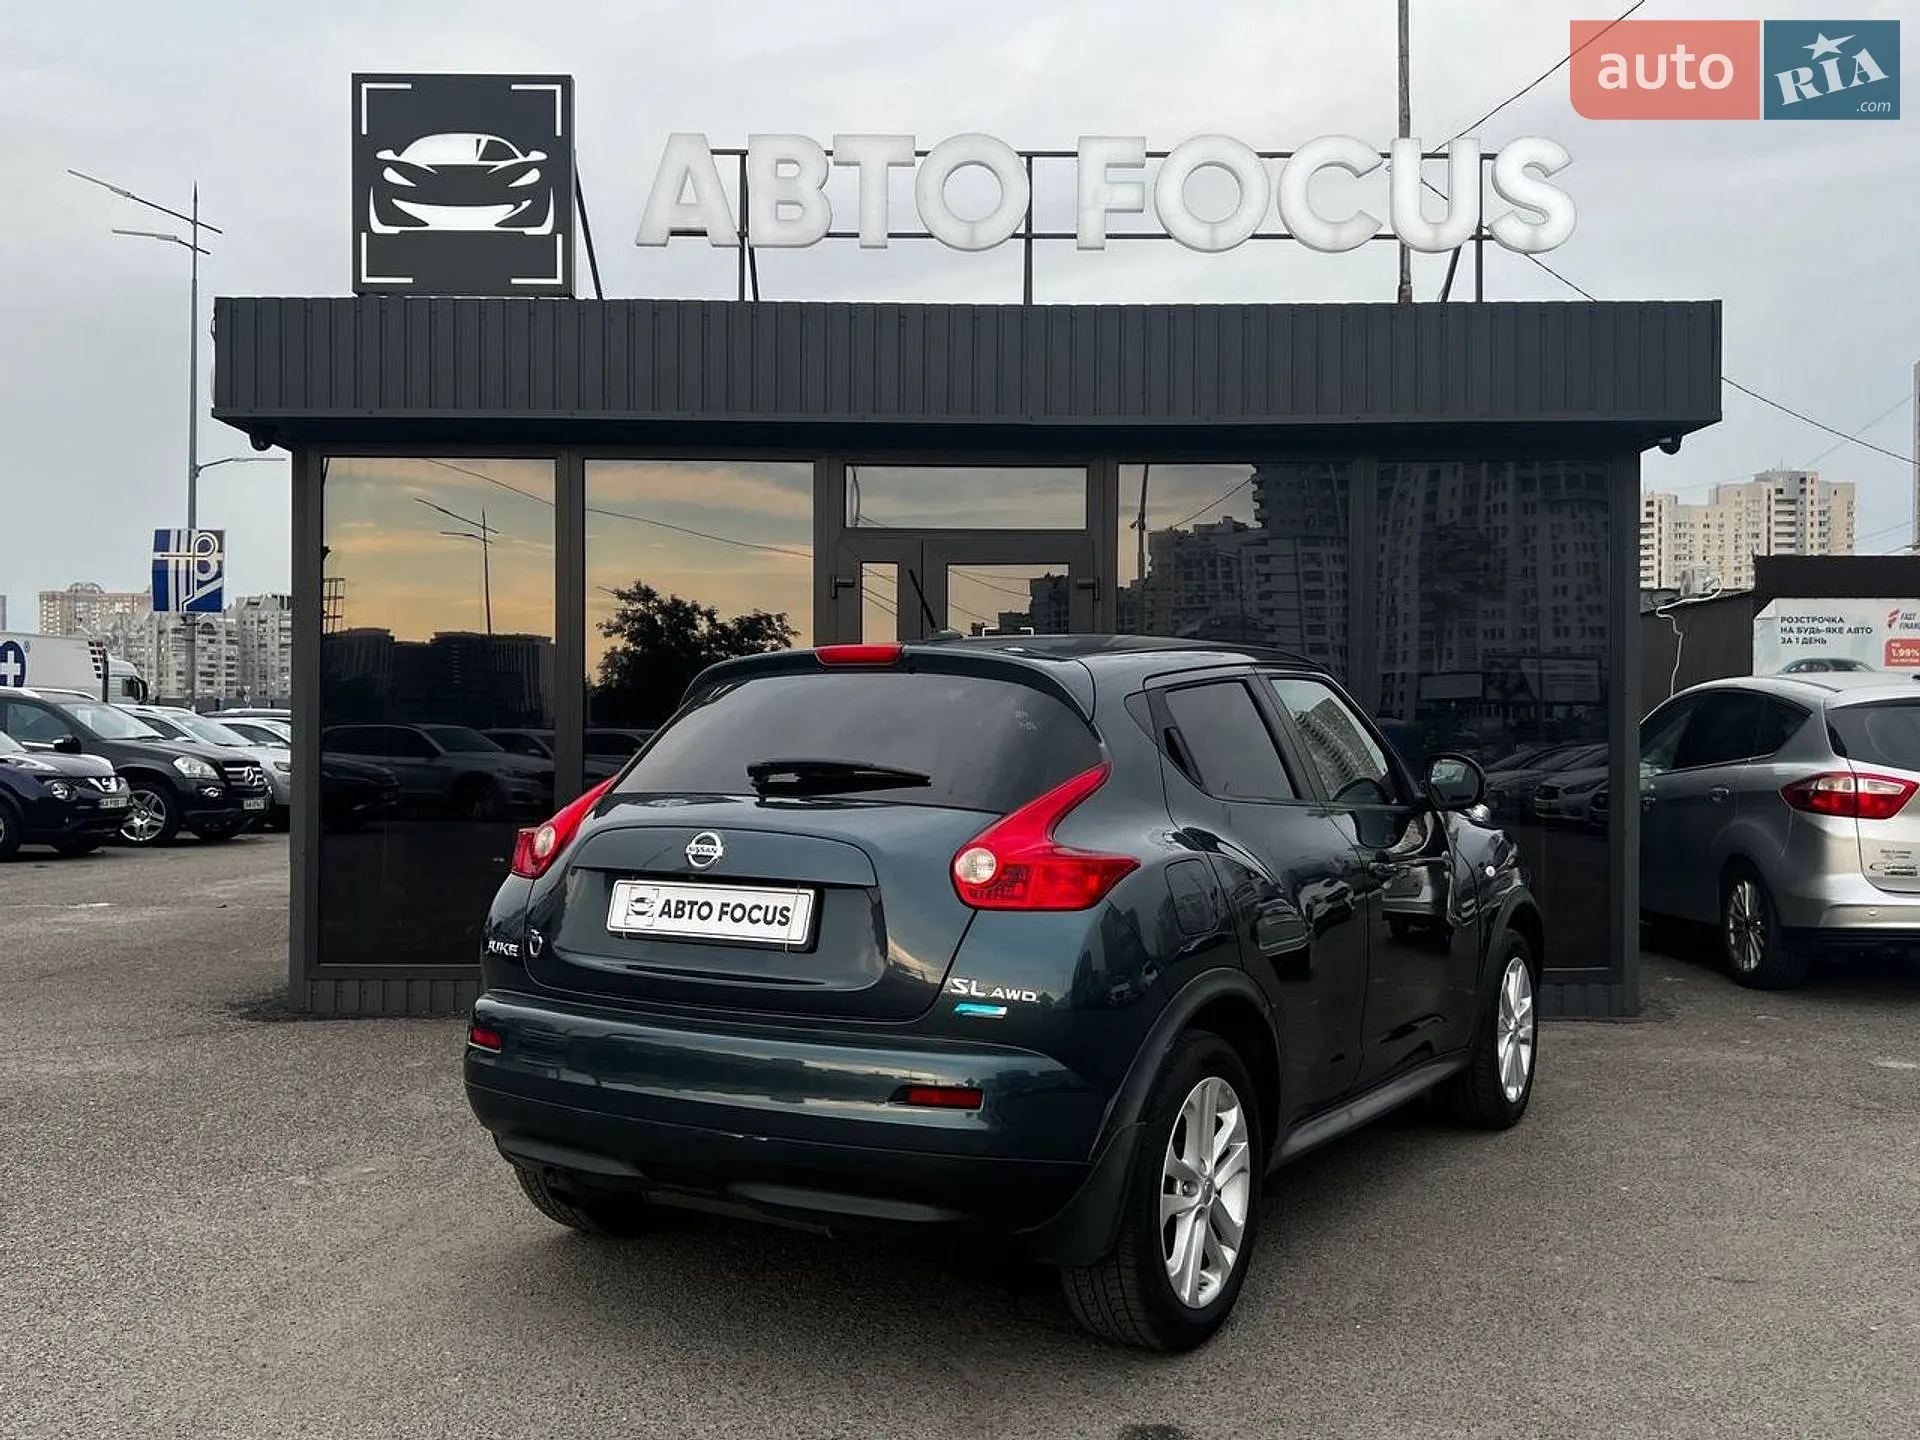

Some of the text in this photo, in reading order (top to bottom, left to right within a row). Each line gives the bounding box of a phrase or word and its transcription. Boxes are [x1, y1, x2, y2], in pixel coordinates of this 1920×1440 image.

[635, 132, 1577, 253] АВТО FOCUS
[1780, 615, 1845, 624] РОЗСТРОЧКА
[1780, 626, 1795, 635] НА
[1846, 626, 1874, 635] АВТО
[1780, 636, 1793, 645] ЗА
[1801, 636, 1828, 646] ДЕНЬ
[658, 898, 792, 927] АВТО FOCUS
[484, 940, 519, 957] JUKE
[949, 977, 1038, 1002] SL AWD
